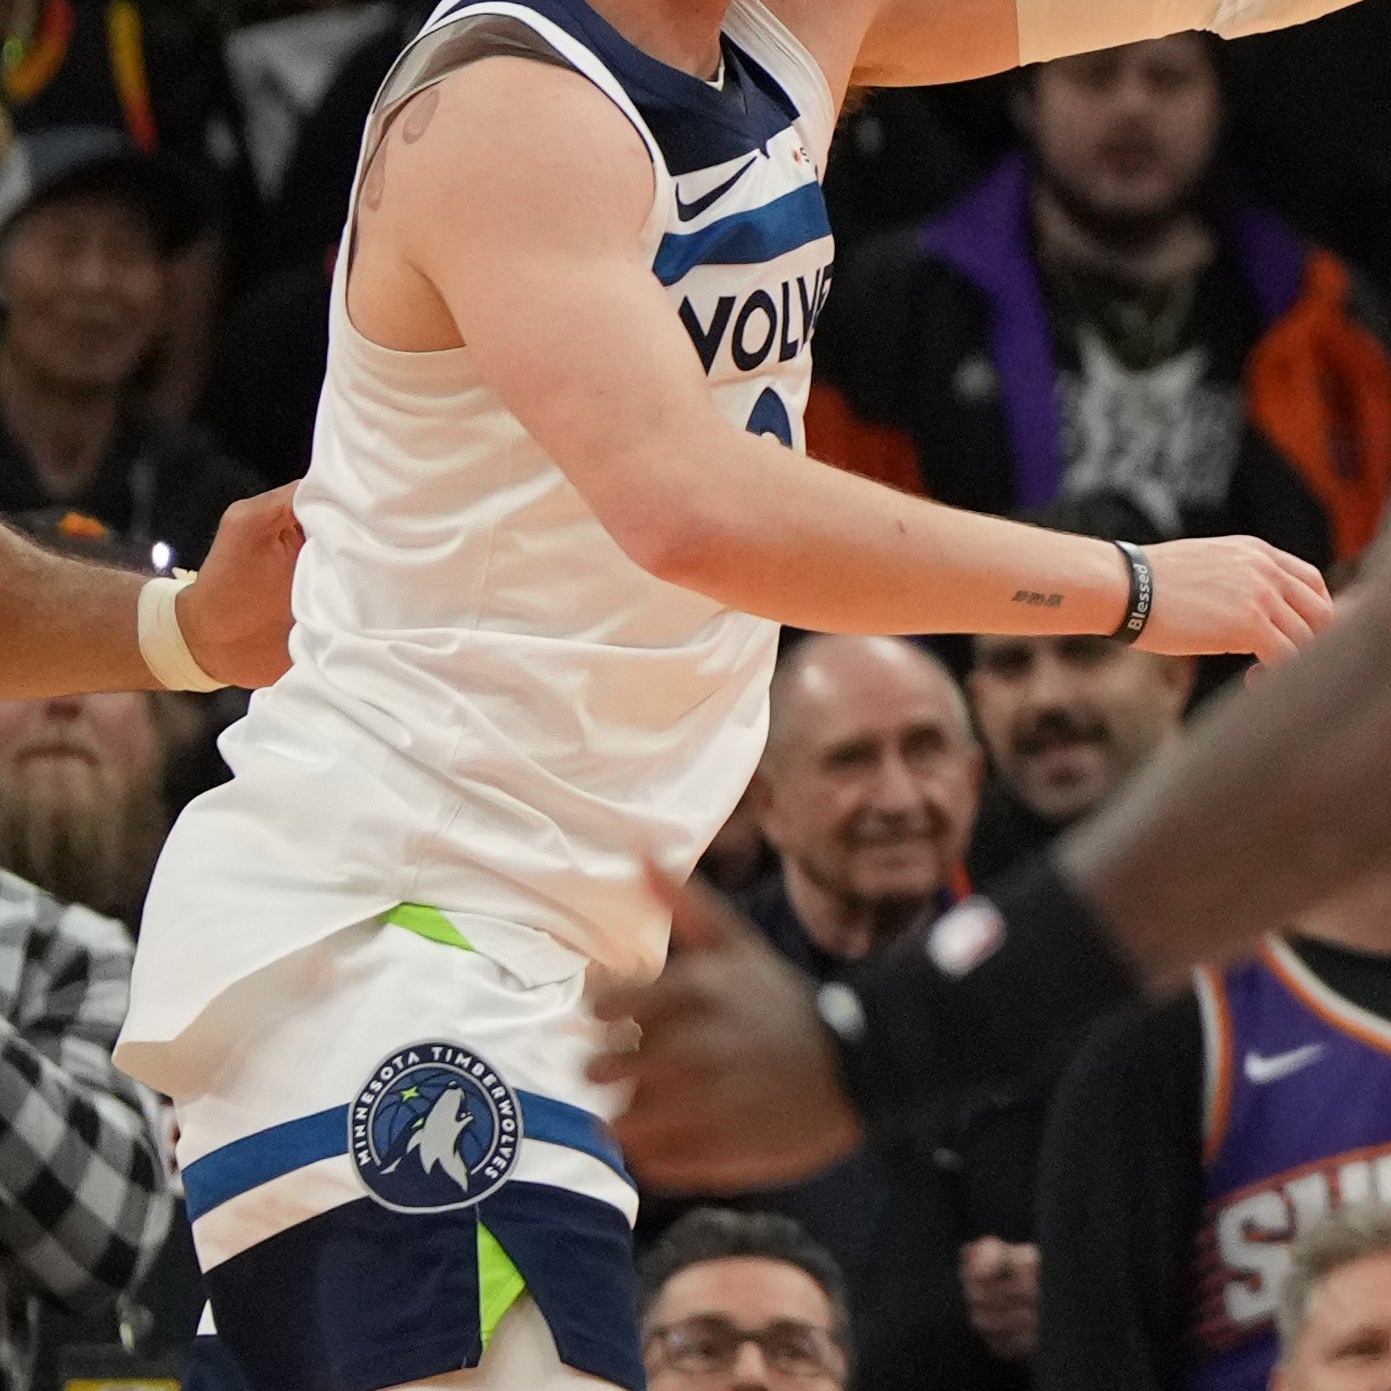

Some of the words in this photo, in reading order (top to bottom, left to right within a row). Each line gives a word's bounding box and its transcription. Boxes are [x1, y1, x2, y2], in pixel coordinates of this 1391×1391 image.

[1127, 563, 1152, 632] Blessed
[354, 1052, 420, 1166] MINNESOTA
[431, 1046, 516, 1179] TIMBERWOLVES
